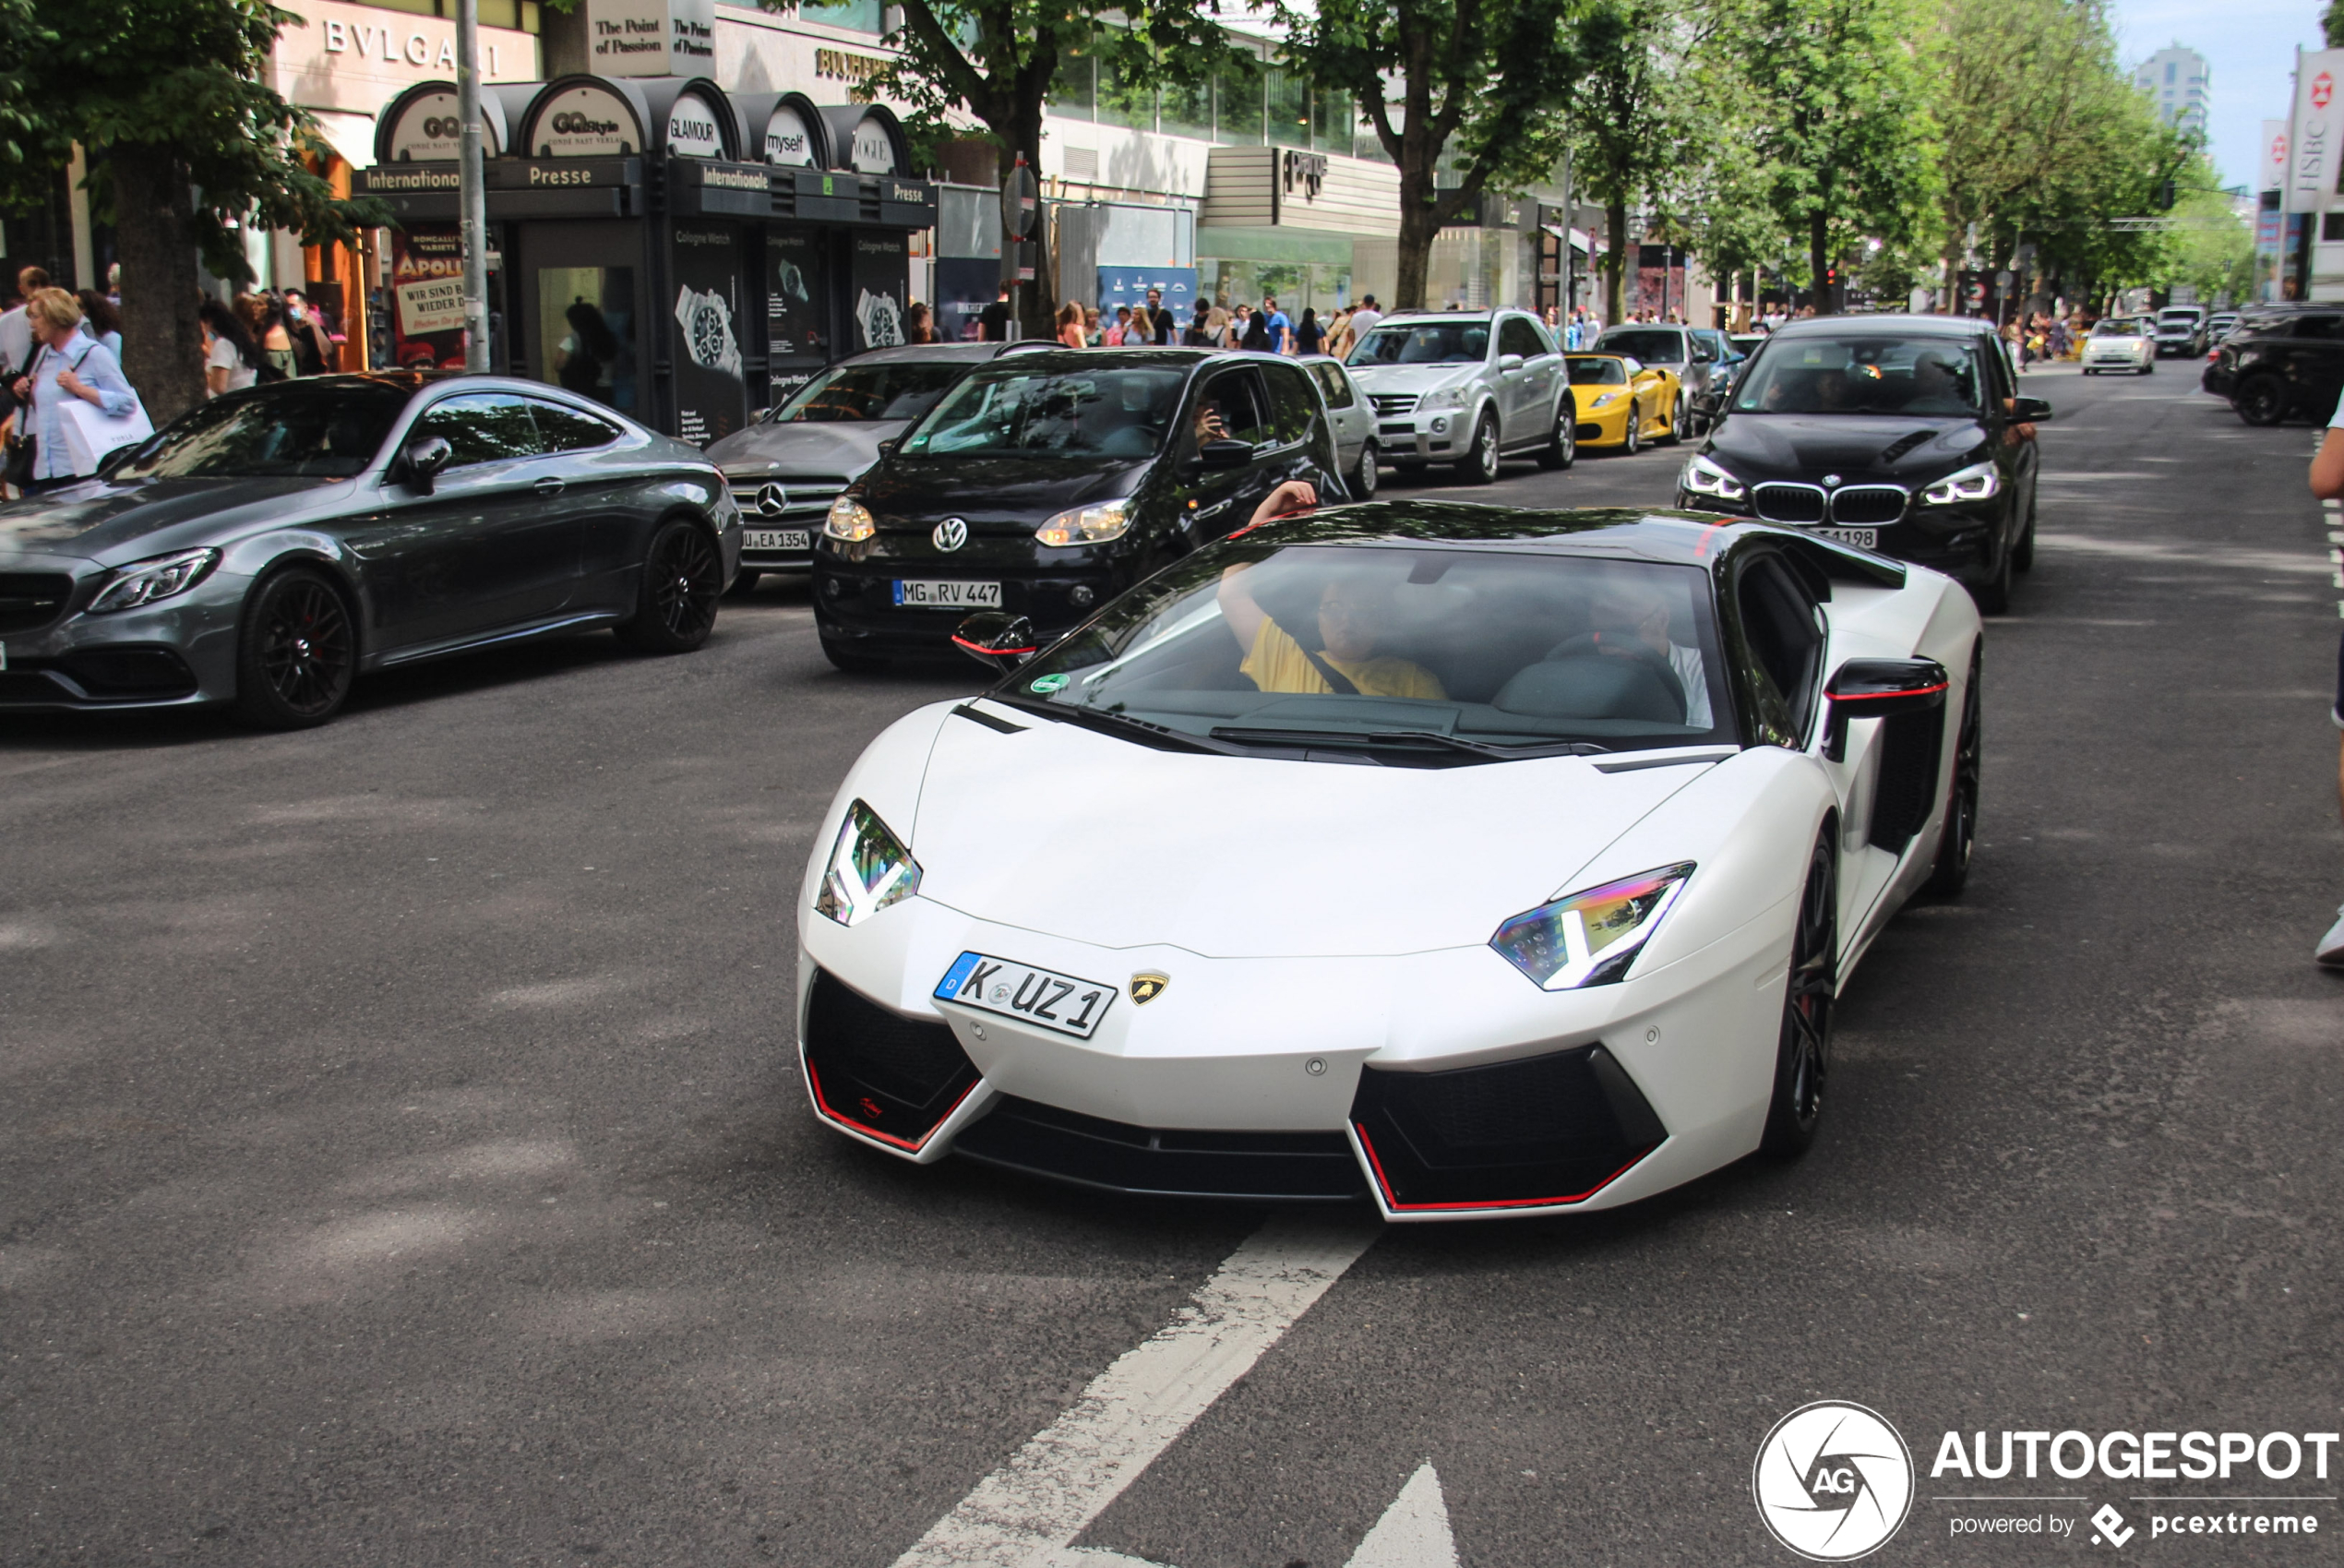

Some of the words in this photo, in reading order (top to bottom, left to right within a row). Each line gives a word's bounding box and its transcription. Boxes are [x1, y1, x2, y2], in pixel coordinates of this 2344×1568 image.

[595, 20, 622, 35] The
[626, 18, 659, 33] Point
[674, 19, 689, 35] The
[324, 19, 499, 77] BVLGAI
[596, 40, 610, 54] of
[613, 38, 662, 54] Passion
[424, 116, 460, 139] GQ
[670, 118, 713, 142] GLAMOUR
[768, 134, 804, 154] myself
[2296, 120, 2326, 192] HSBC
[366, 170, 460, 189] Internationa
[530, 167, 592, 185] Presse
[703, 166, 769, 189] Internationale
[893, 185, 923, 202] Presse
[676, 231, 707, 246] Cologne
[708, 232, 730, 245] Watch
[857, 240, 881, 254] Cologne
[882, 242, 901, 253] Watch
[398, 250, 463, 276] APOLL
[407, 292, 426, 302] WIR
[429, 286, 453, 299] SIND
[417, 300, 456, 313] WIEDER
[760, 533, 775, 546] EA
[778, 533, 807, 546] 1354
[903, 583, 926, 602] MG
[939, 584, 961, 602] RV
[966, 584, 999, 603] 447
[946, 979, 956, 990] D
[961, 961, 1002, 999] K
[1011, 973, 1075, 1020] UZ
[1066, 990, 1101, 1029] 1
